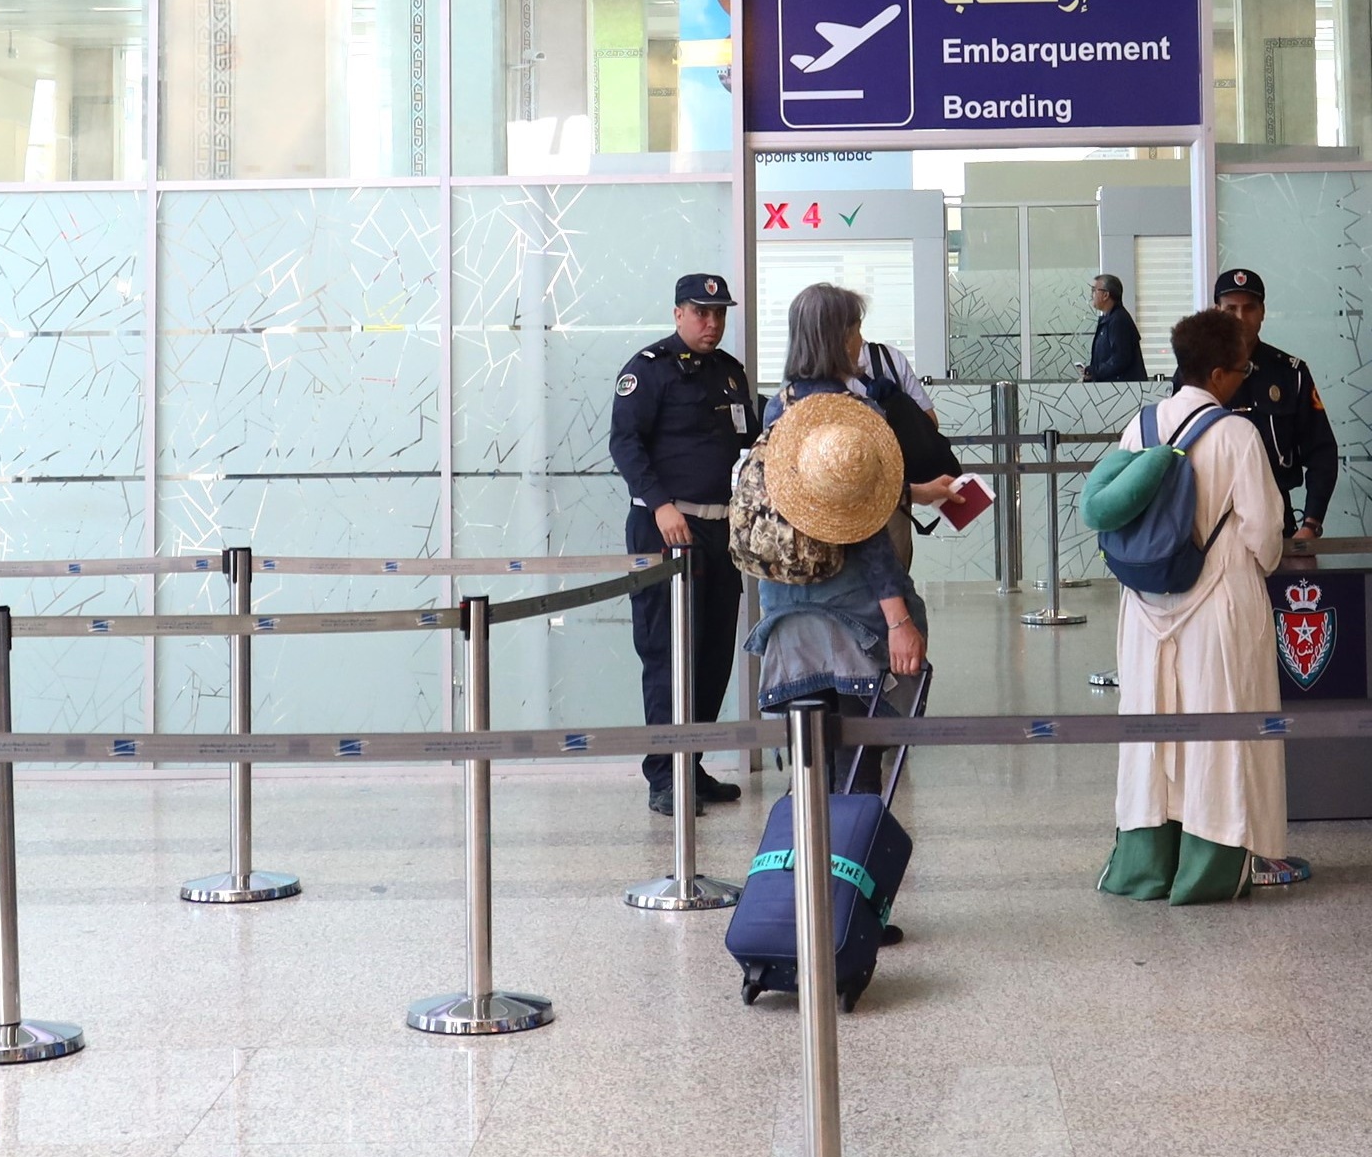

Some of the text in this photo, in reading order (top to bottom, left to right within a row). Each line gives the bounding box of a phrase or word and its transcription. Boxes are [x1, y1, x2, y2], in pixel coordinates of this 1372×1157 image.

[942, 36, 1171, 67] Embarquement
[943, 95, 1073, 123] Boarding
[756, 151, 797, 166] oports
[802, 202, 822, 229] 4
